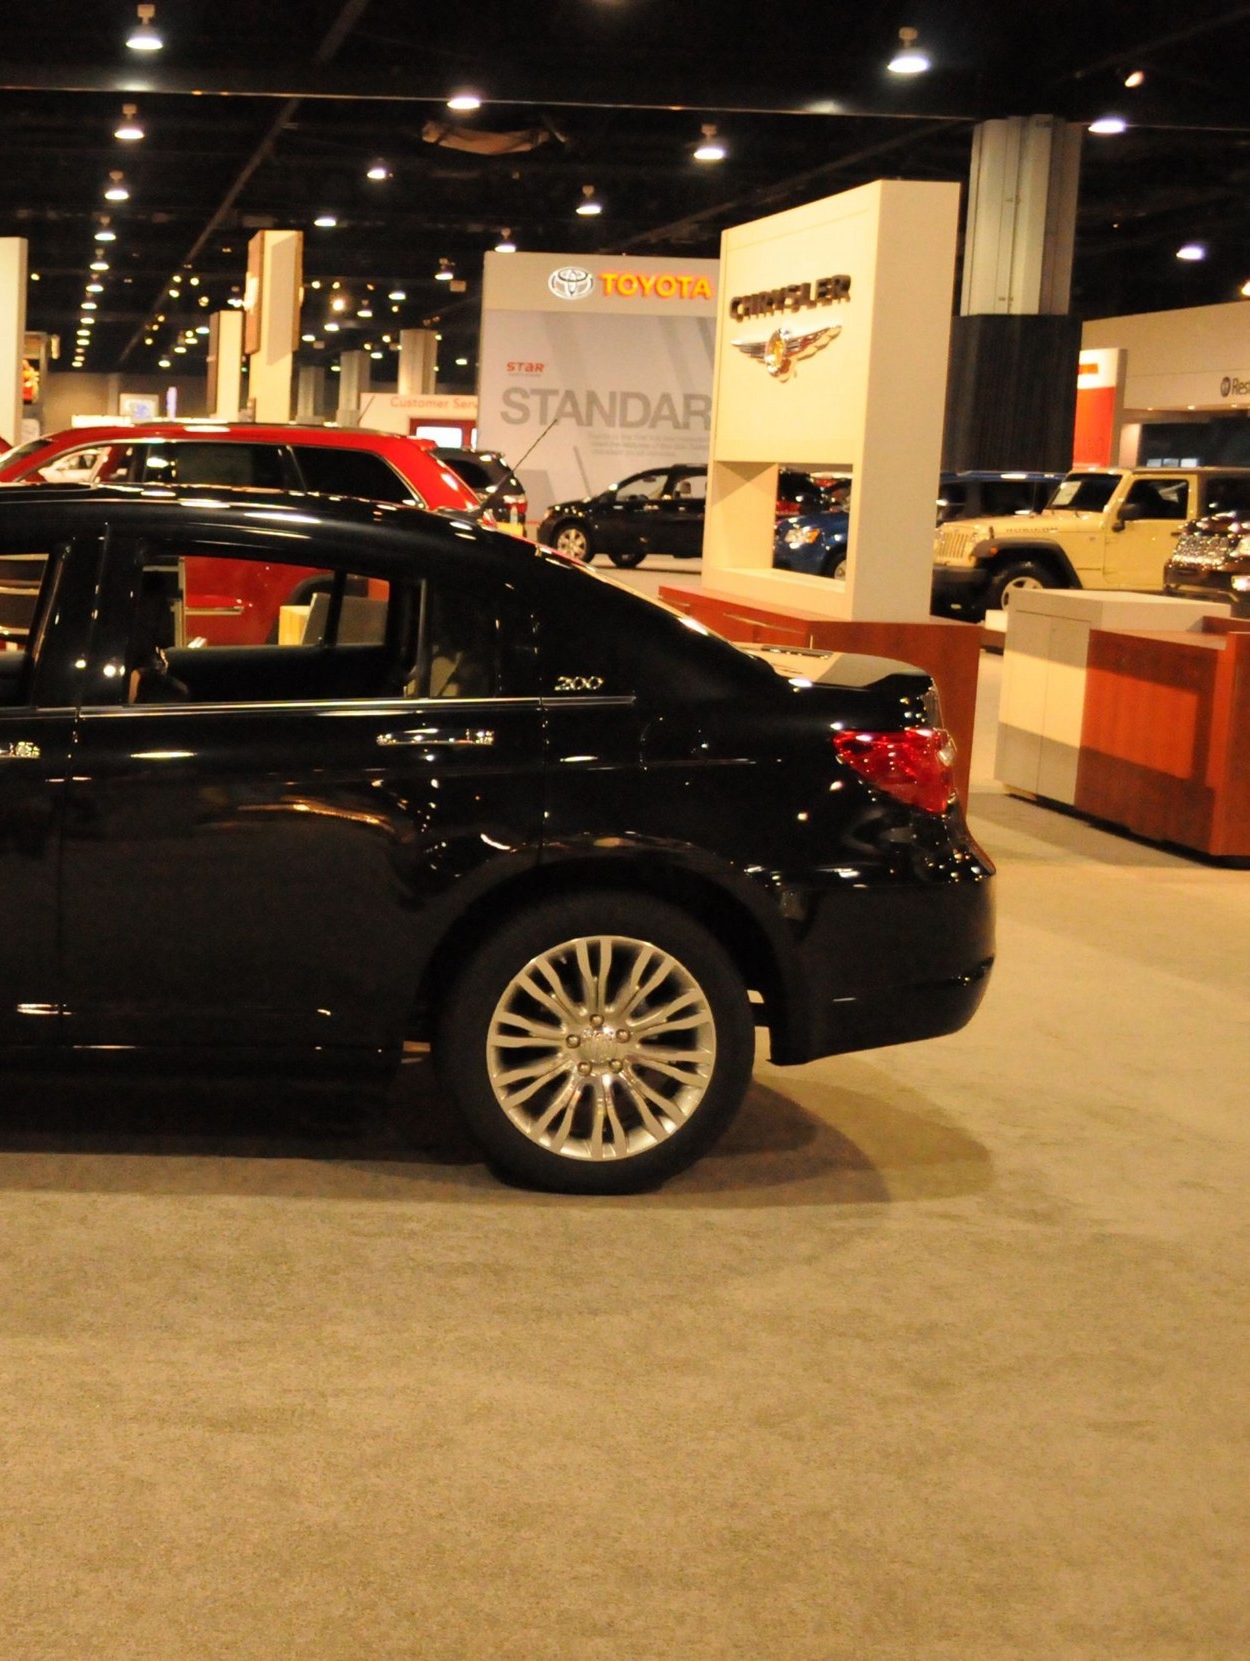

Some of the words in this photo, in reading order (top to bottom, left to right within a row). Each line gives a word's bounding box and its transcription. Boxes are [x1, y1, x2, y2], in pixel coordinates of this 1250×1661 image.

[600, 272, 712, 299] TOYOTA
[729, 274, 852, 323] CHRYSLER
[390, 396, 449, 408] Customer
[554, 675, 604, 691] 200
